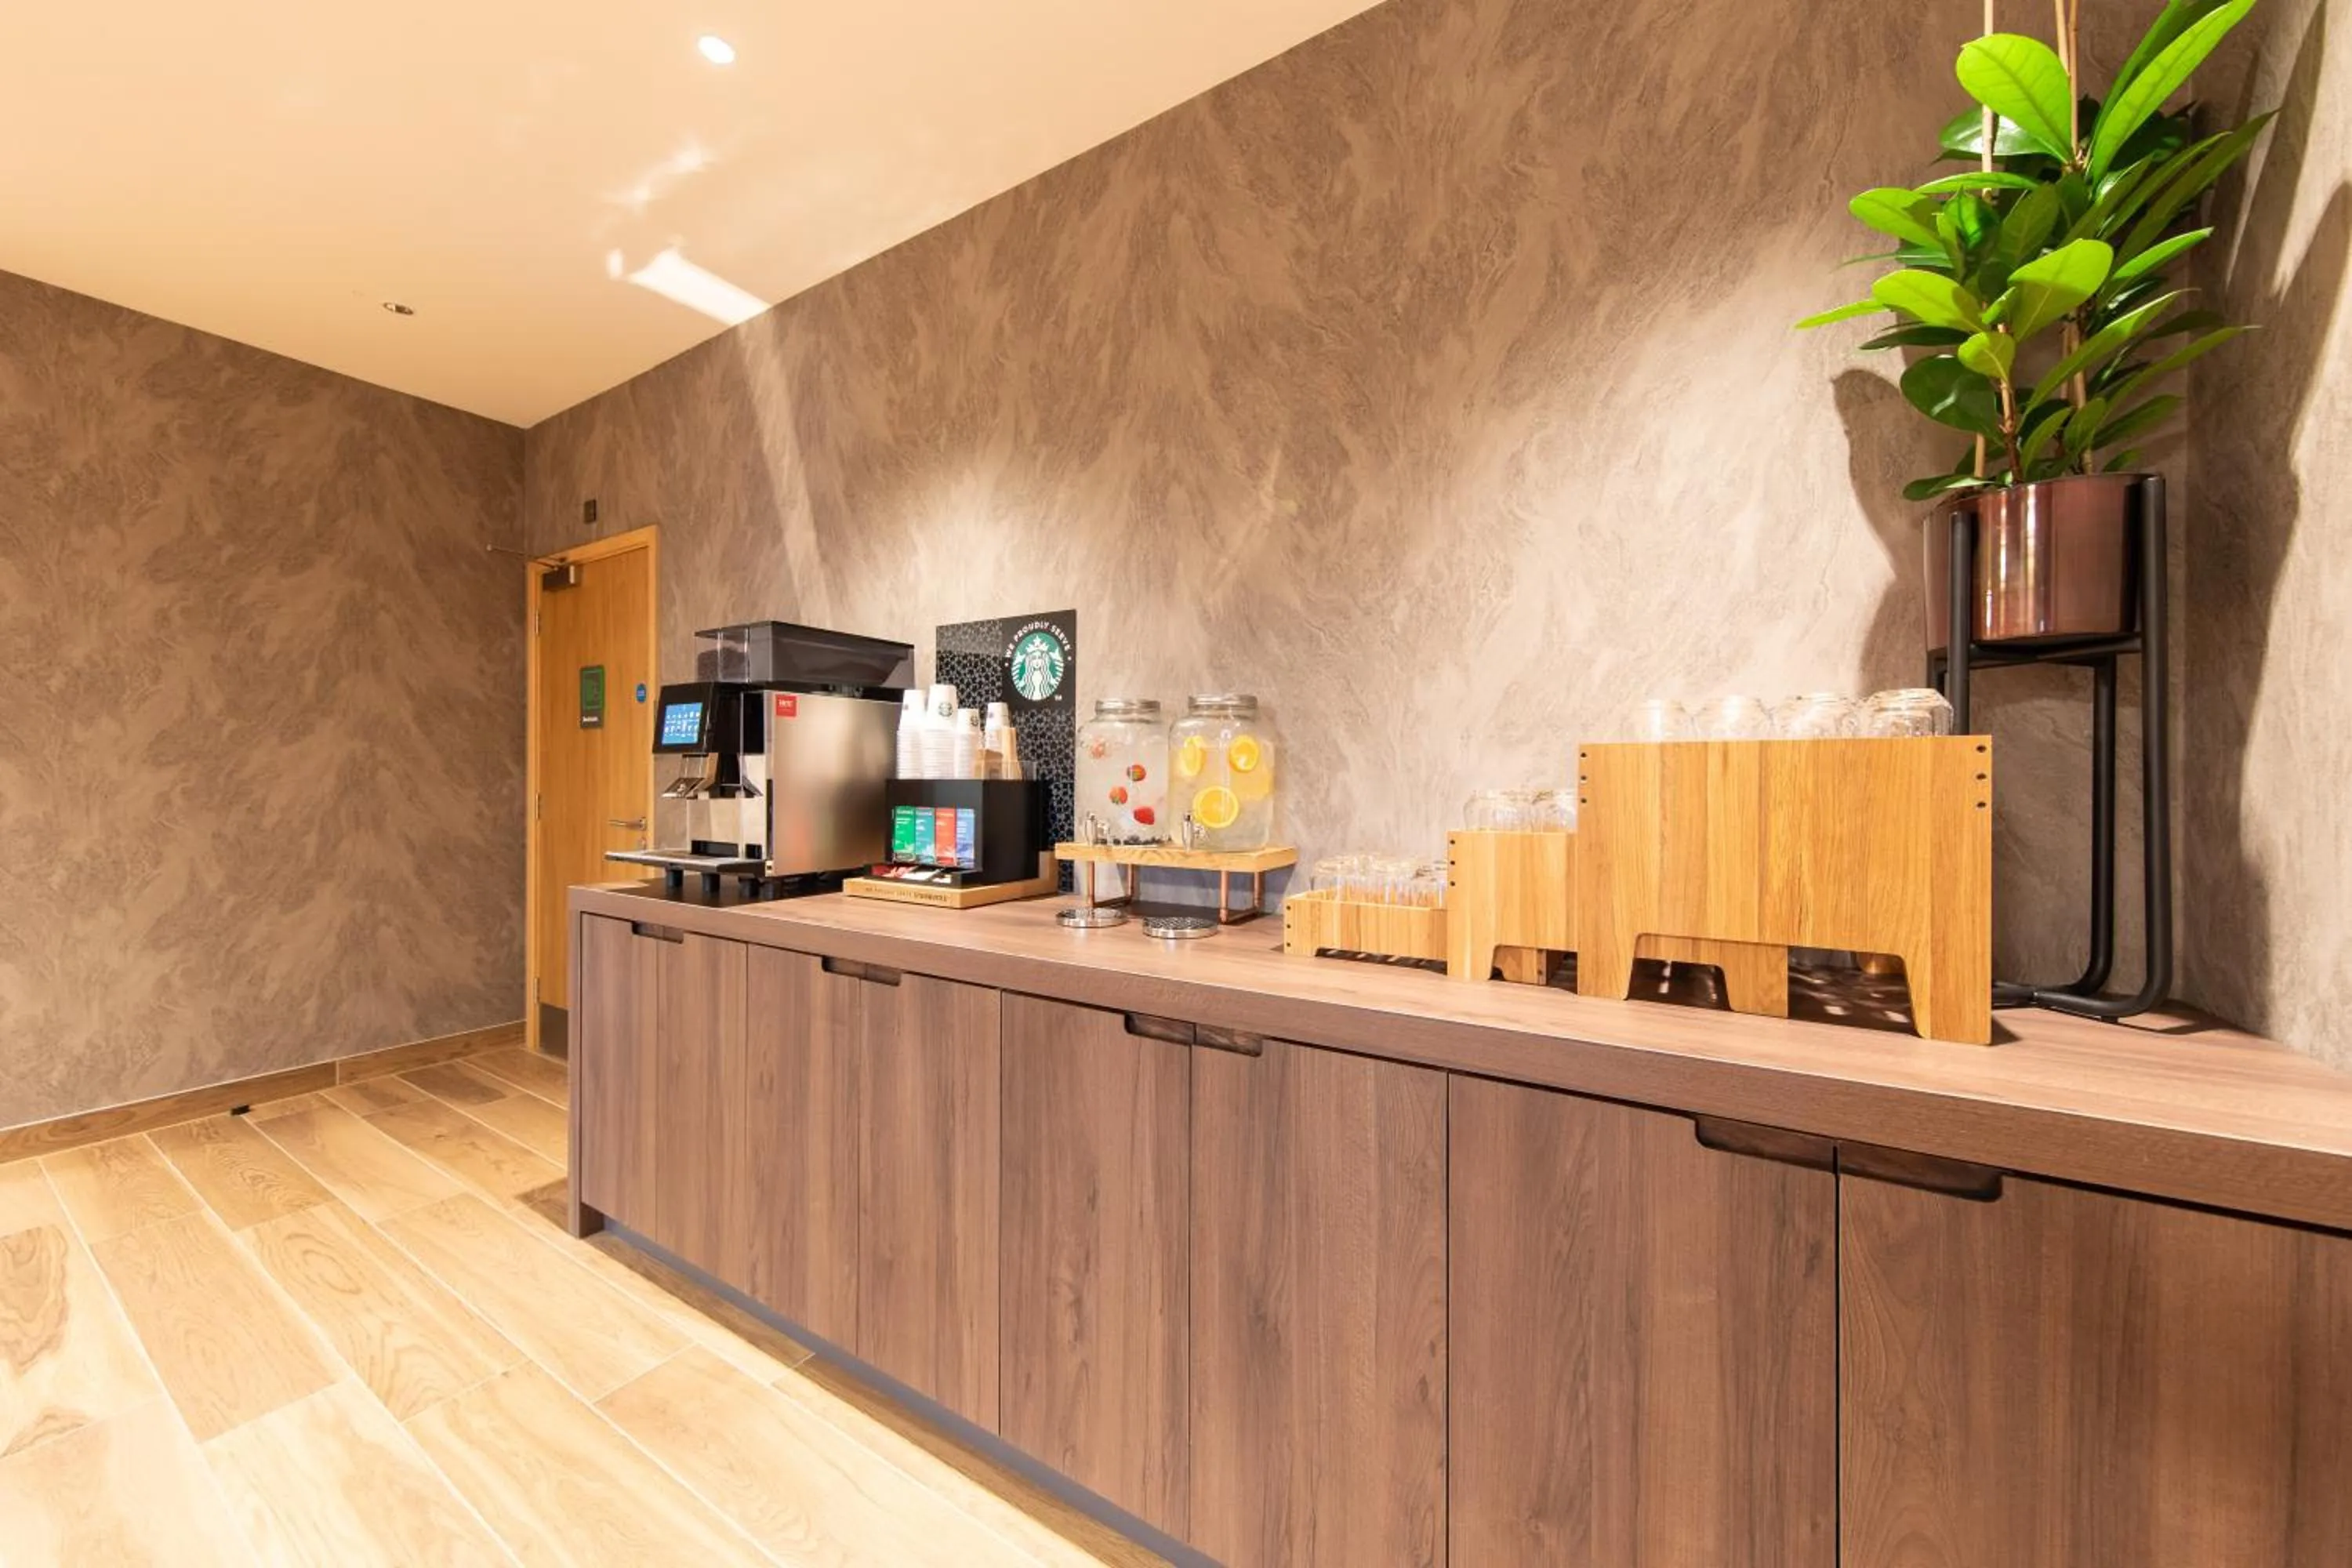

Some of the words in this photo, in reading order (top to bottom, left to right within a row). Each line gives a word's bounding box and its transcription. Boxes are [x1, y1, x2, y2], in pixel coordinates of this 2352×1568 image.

[1005, 643, 1014, 657] WE
[1014, 621, 1049, 641] PROUDLY
[1051, 625, 1070, 651] SERVE
